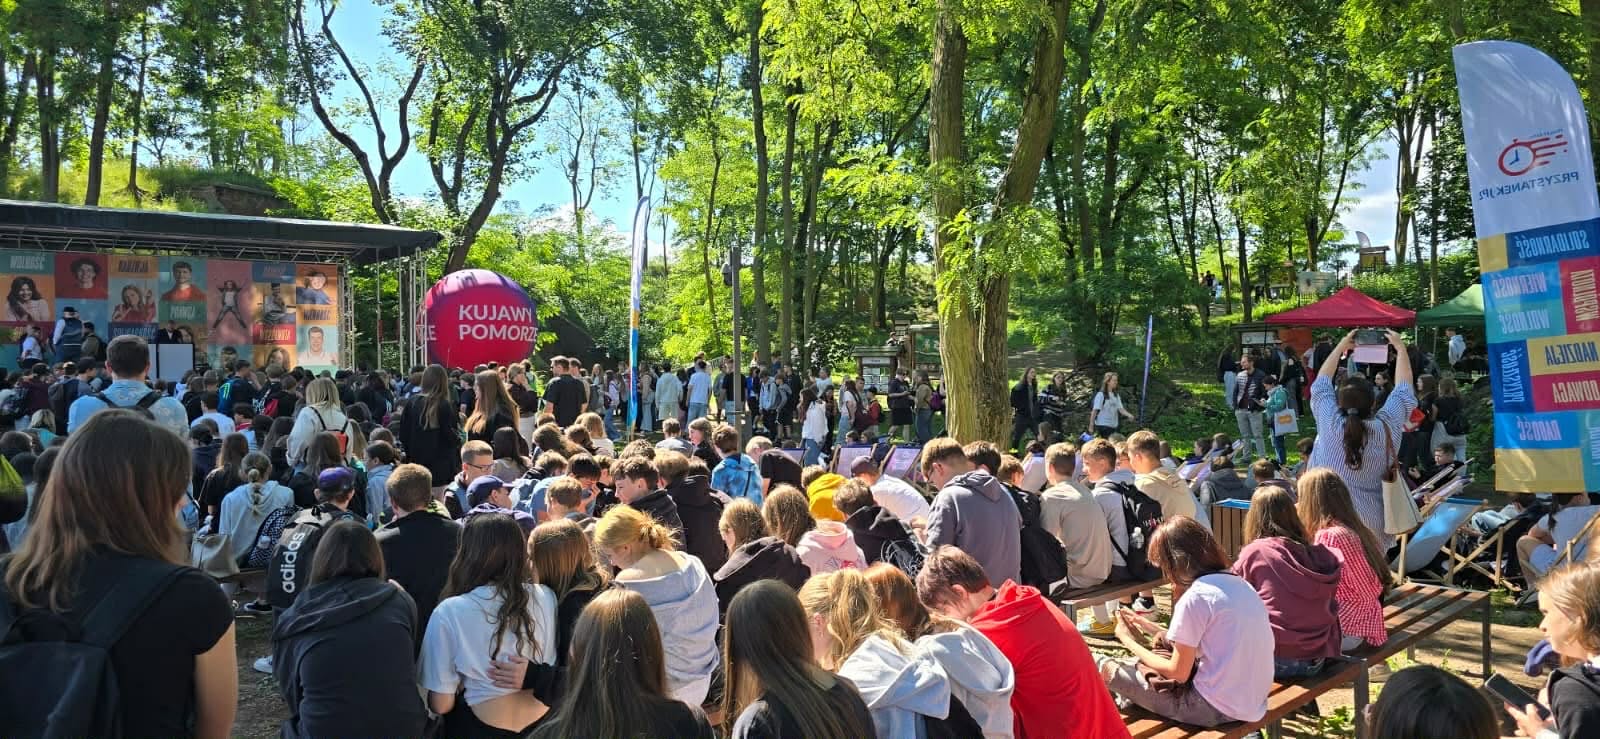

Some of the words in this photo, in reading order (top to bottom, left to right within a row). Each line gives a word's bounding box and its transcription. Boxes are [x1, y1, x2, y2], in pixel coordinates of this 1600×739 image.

[459, 304, 532, 323] KUJAWY
[459, 324, 538, 342] POMORZE
[280, 532, 305, 593] adidas
